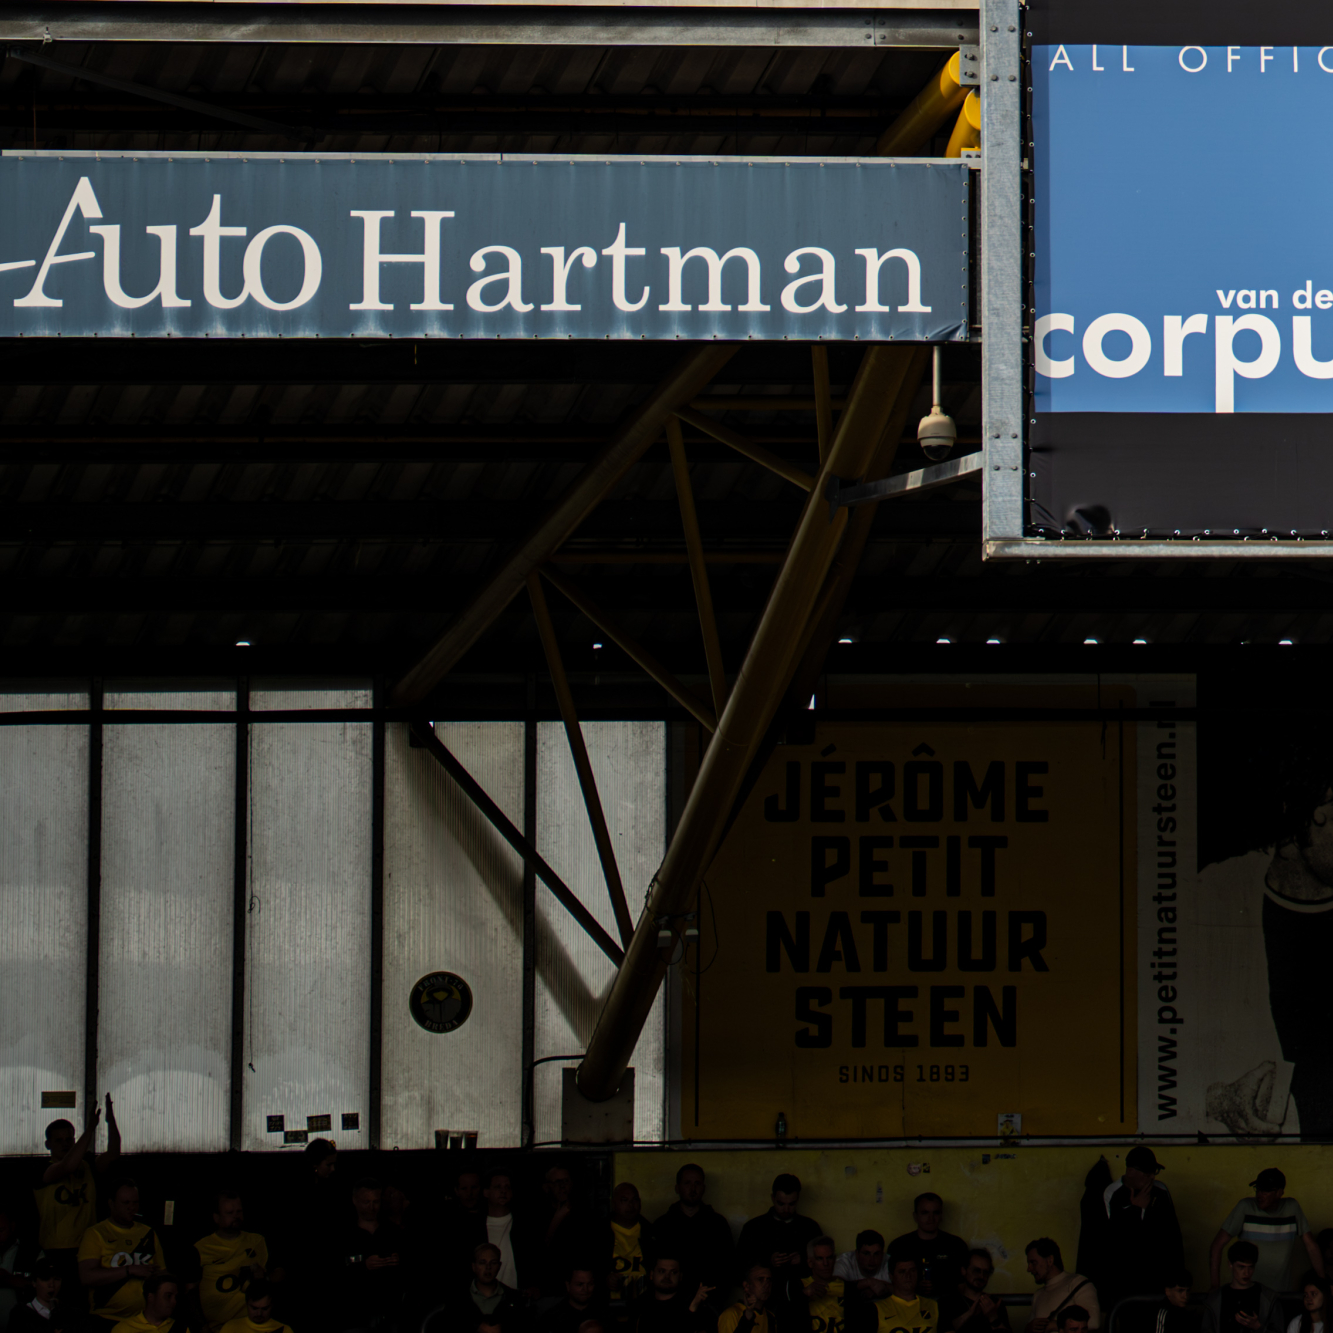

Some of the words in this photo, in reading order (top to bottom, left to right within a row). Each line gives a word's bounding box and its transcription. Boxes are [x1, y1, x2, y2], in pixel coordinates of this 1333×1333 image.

[1049, 44, 1135, 72] ALL
[0, 176, 323, 311] Auto
[349, 210, 932, 315] Hartman
[1216, 288, 1279, 309] van
[764, 742, 1049, 823] JÉRÔME
[811, 836, 1008, 897] PETIT
[765, 910, 1050, 973] NATUUR
[423, 1019, 459, 1031] BREDA
[794, 985, 1017, 1048] STEEN
[839, 1065, 905, 1083] SINDS
[917, 1065, 970, 1083] 1893
[110, 1251, 153, 1268] OK
